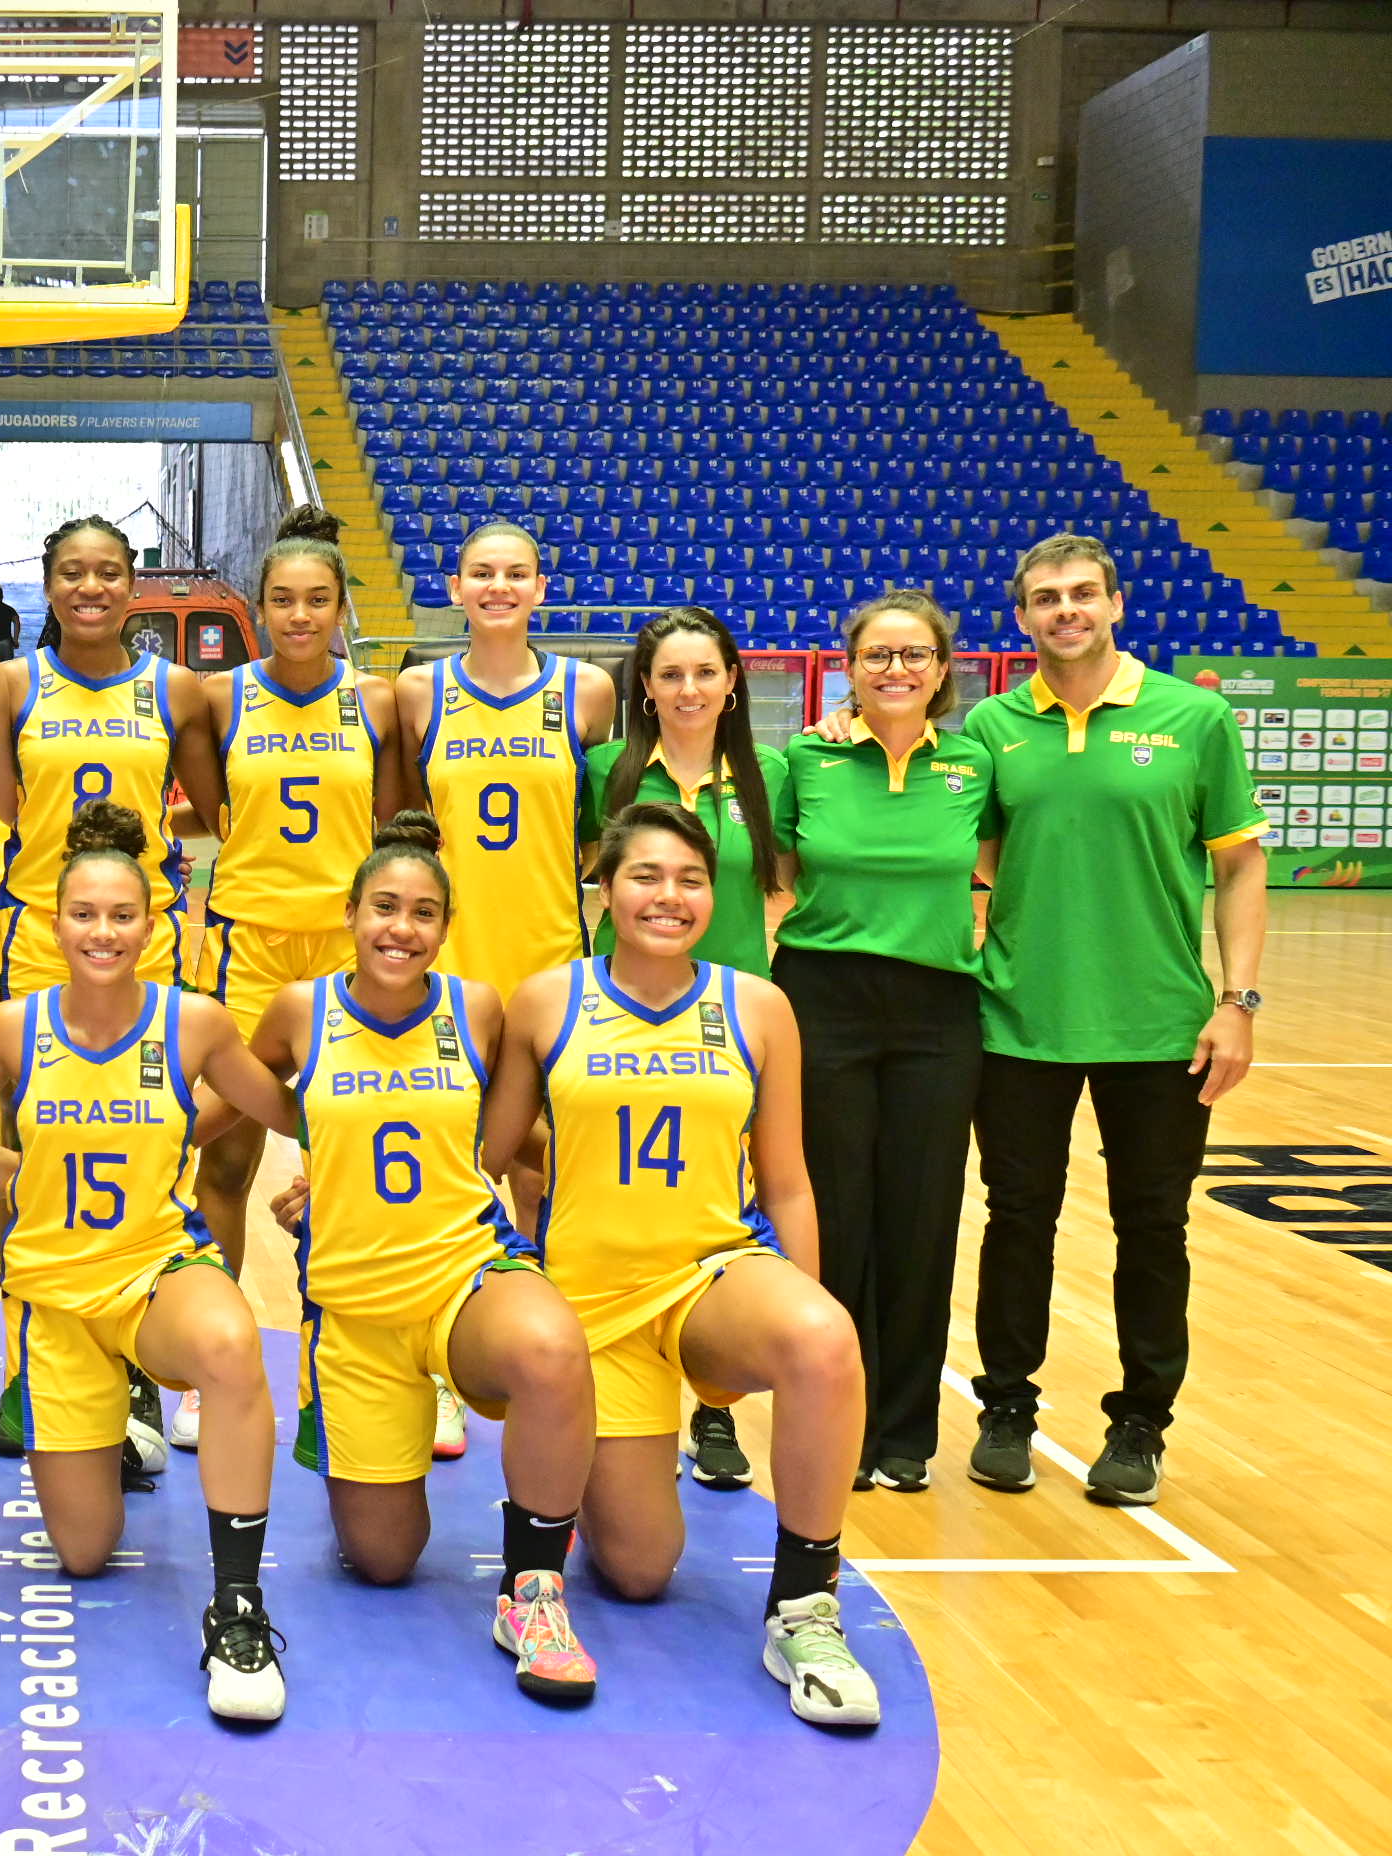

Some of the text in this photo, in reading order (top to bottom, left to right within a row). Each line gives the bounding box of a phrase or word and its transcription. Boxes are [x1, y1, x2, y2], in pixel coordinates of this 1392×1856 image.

[1314, 276, 1335, 293] ES
[139, 416, 201, 428] ENTRANCE
[41, 718, 151, 741] BRASIL
[1109, 730, 1180, 748] BRASIL
[246, 733, 356, 755] BRASIL
[445, 736, 556, 760] BRASIL
[931, 761, 978, 777] BRASIL
[280, 776, 320, 844] 5
[476, 783, 519, 850] 9
[586, 1051, 730, 1077] BRASIL
[332, 1066, 465, 1097] BRASIL
[36, 1100, 165, 1125] BRASIL
[615, 1104, 686, 1188] 14
[372, 1121, 422, 1204] 6
[63, 1152, 128, 1231] 15
